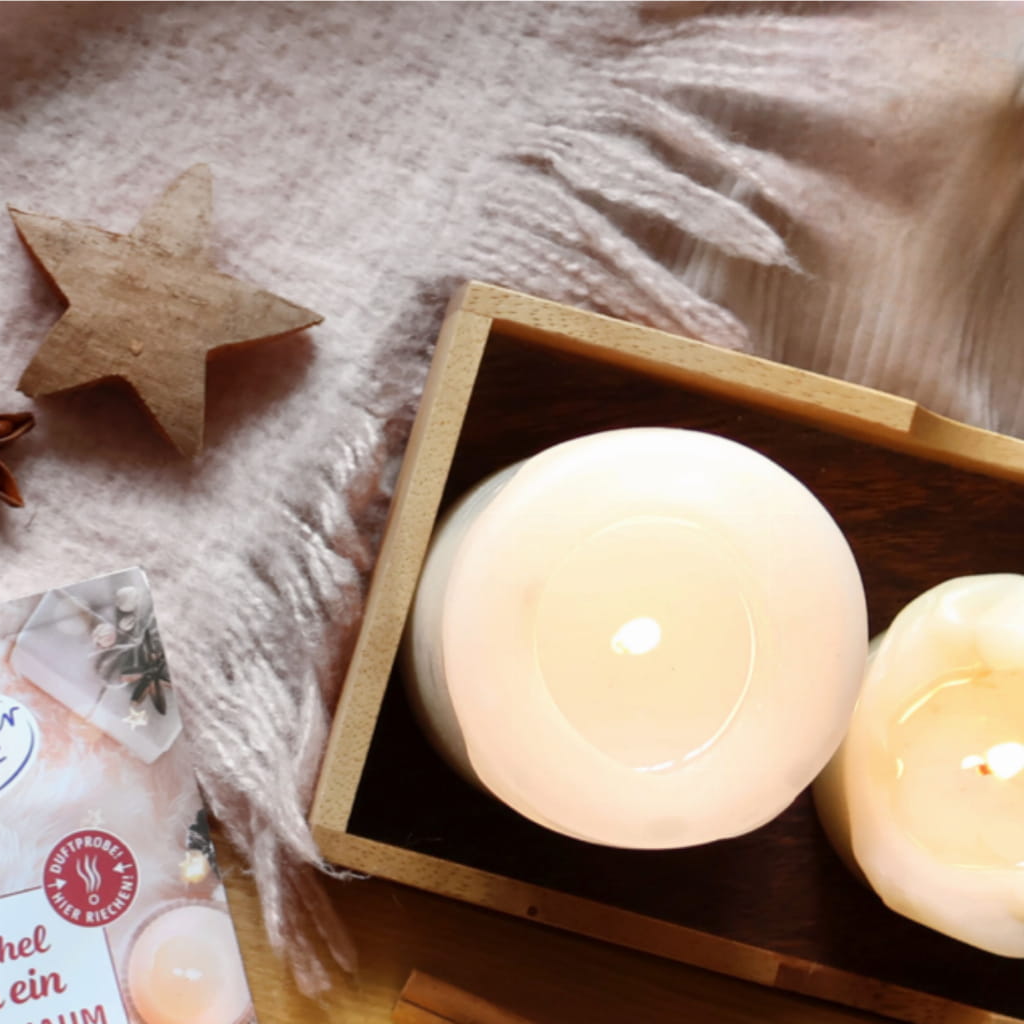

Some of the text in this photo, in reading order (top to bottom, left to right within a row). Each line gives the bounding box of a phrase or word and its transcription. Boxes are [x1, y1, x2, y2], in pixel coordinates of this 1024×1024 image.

[49, 836, 124, 874] DUFTPROBE!
[51, 875, 134, 923] HIER RIECHEN!
[10, 967, 68, 1004] ein
